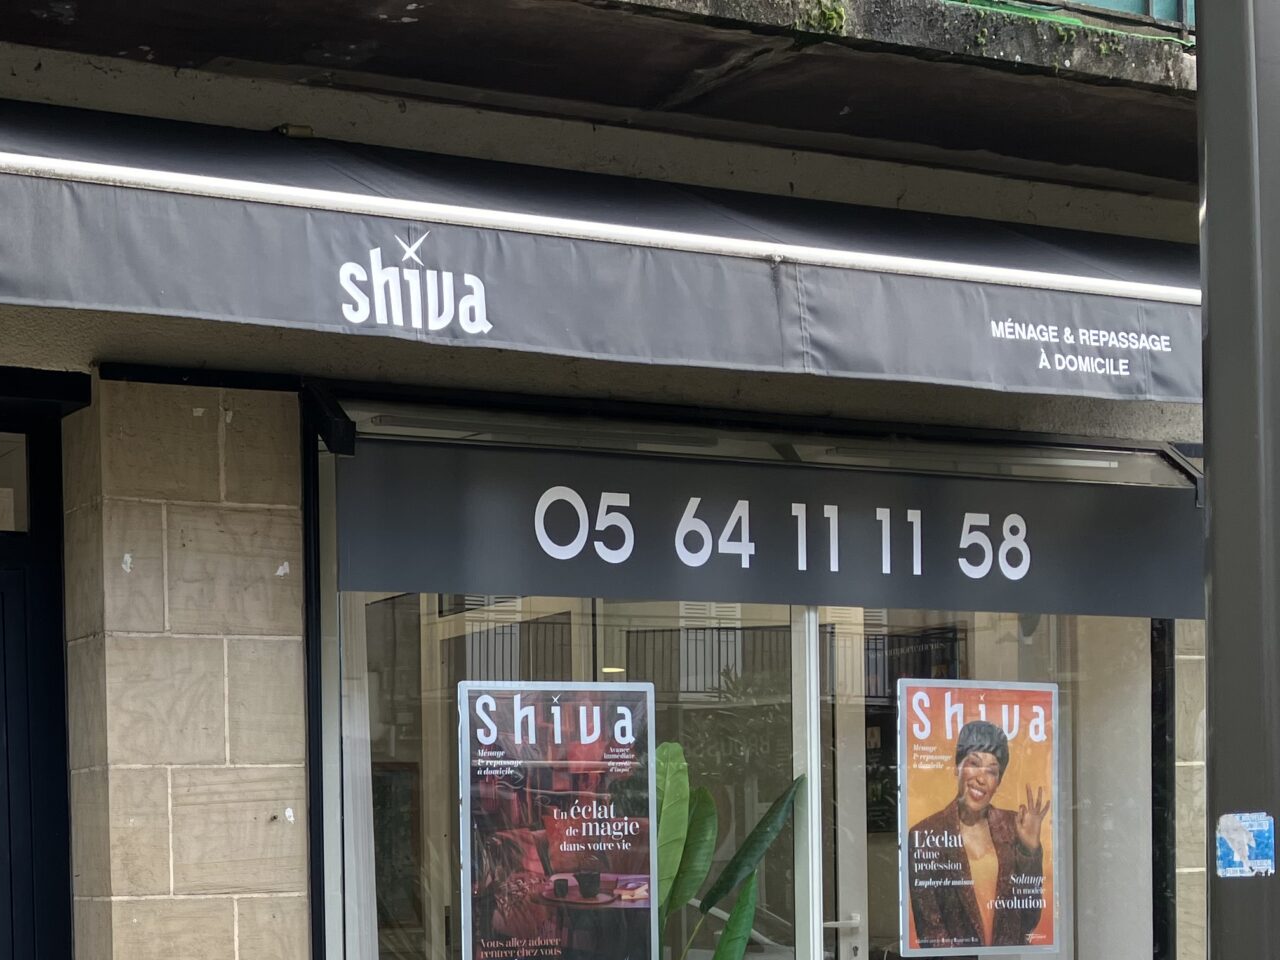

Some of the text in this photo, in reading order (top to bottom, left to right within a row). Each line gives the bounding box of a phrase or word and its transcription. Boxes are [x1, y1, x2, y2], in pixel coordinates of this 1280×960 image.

[339, 231, 494, 334] shiva
[991, 318, 1172, 351] MÉNAGE & REPASSAGE
[1039, 348, 1130, 375] À DOMICILE
[534, 486, 1031, 581] 05 64 11 11 58
[475, 694, 636, 745] Shiva
[485, 759, 522, 768] repassage
[483, 767, 514, 776] domicile
[553, 800, 616, 820] Un éclat
[565, 816, 640, 840] de magie
[560, 839, 632, 851] dans votre vie
[914, 829, 963, 848] L'éclat
[913, 849, 940, 859] d'une
[914, 859, 962, 873] profession
[1010, 873, 1046, 885] Solange
[987, 895, 1047, 910] d'évolution
[481, 936, 561, 949] Vous allez adorer
[480, 948, 562, 959] rentrer chez vous
